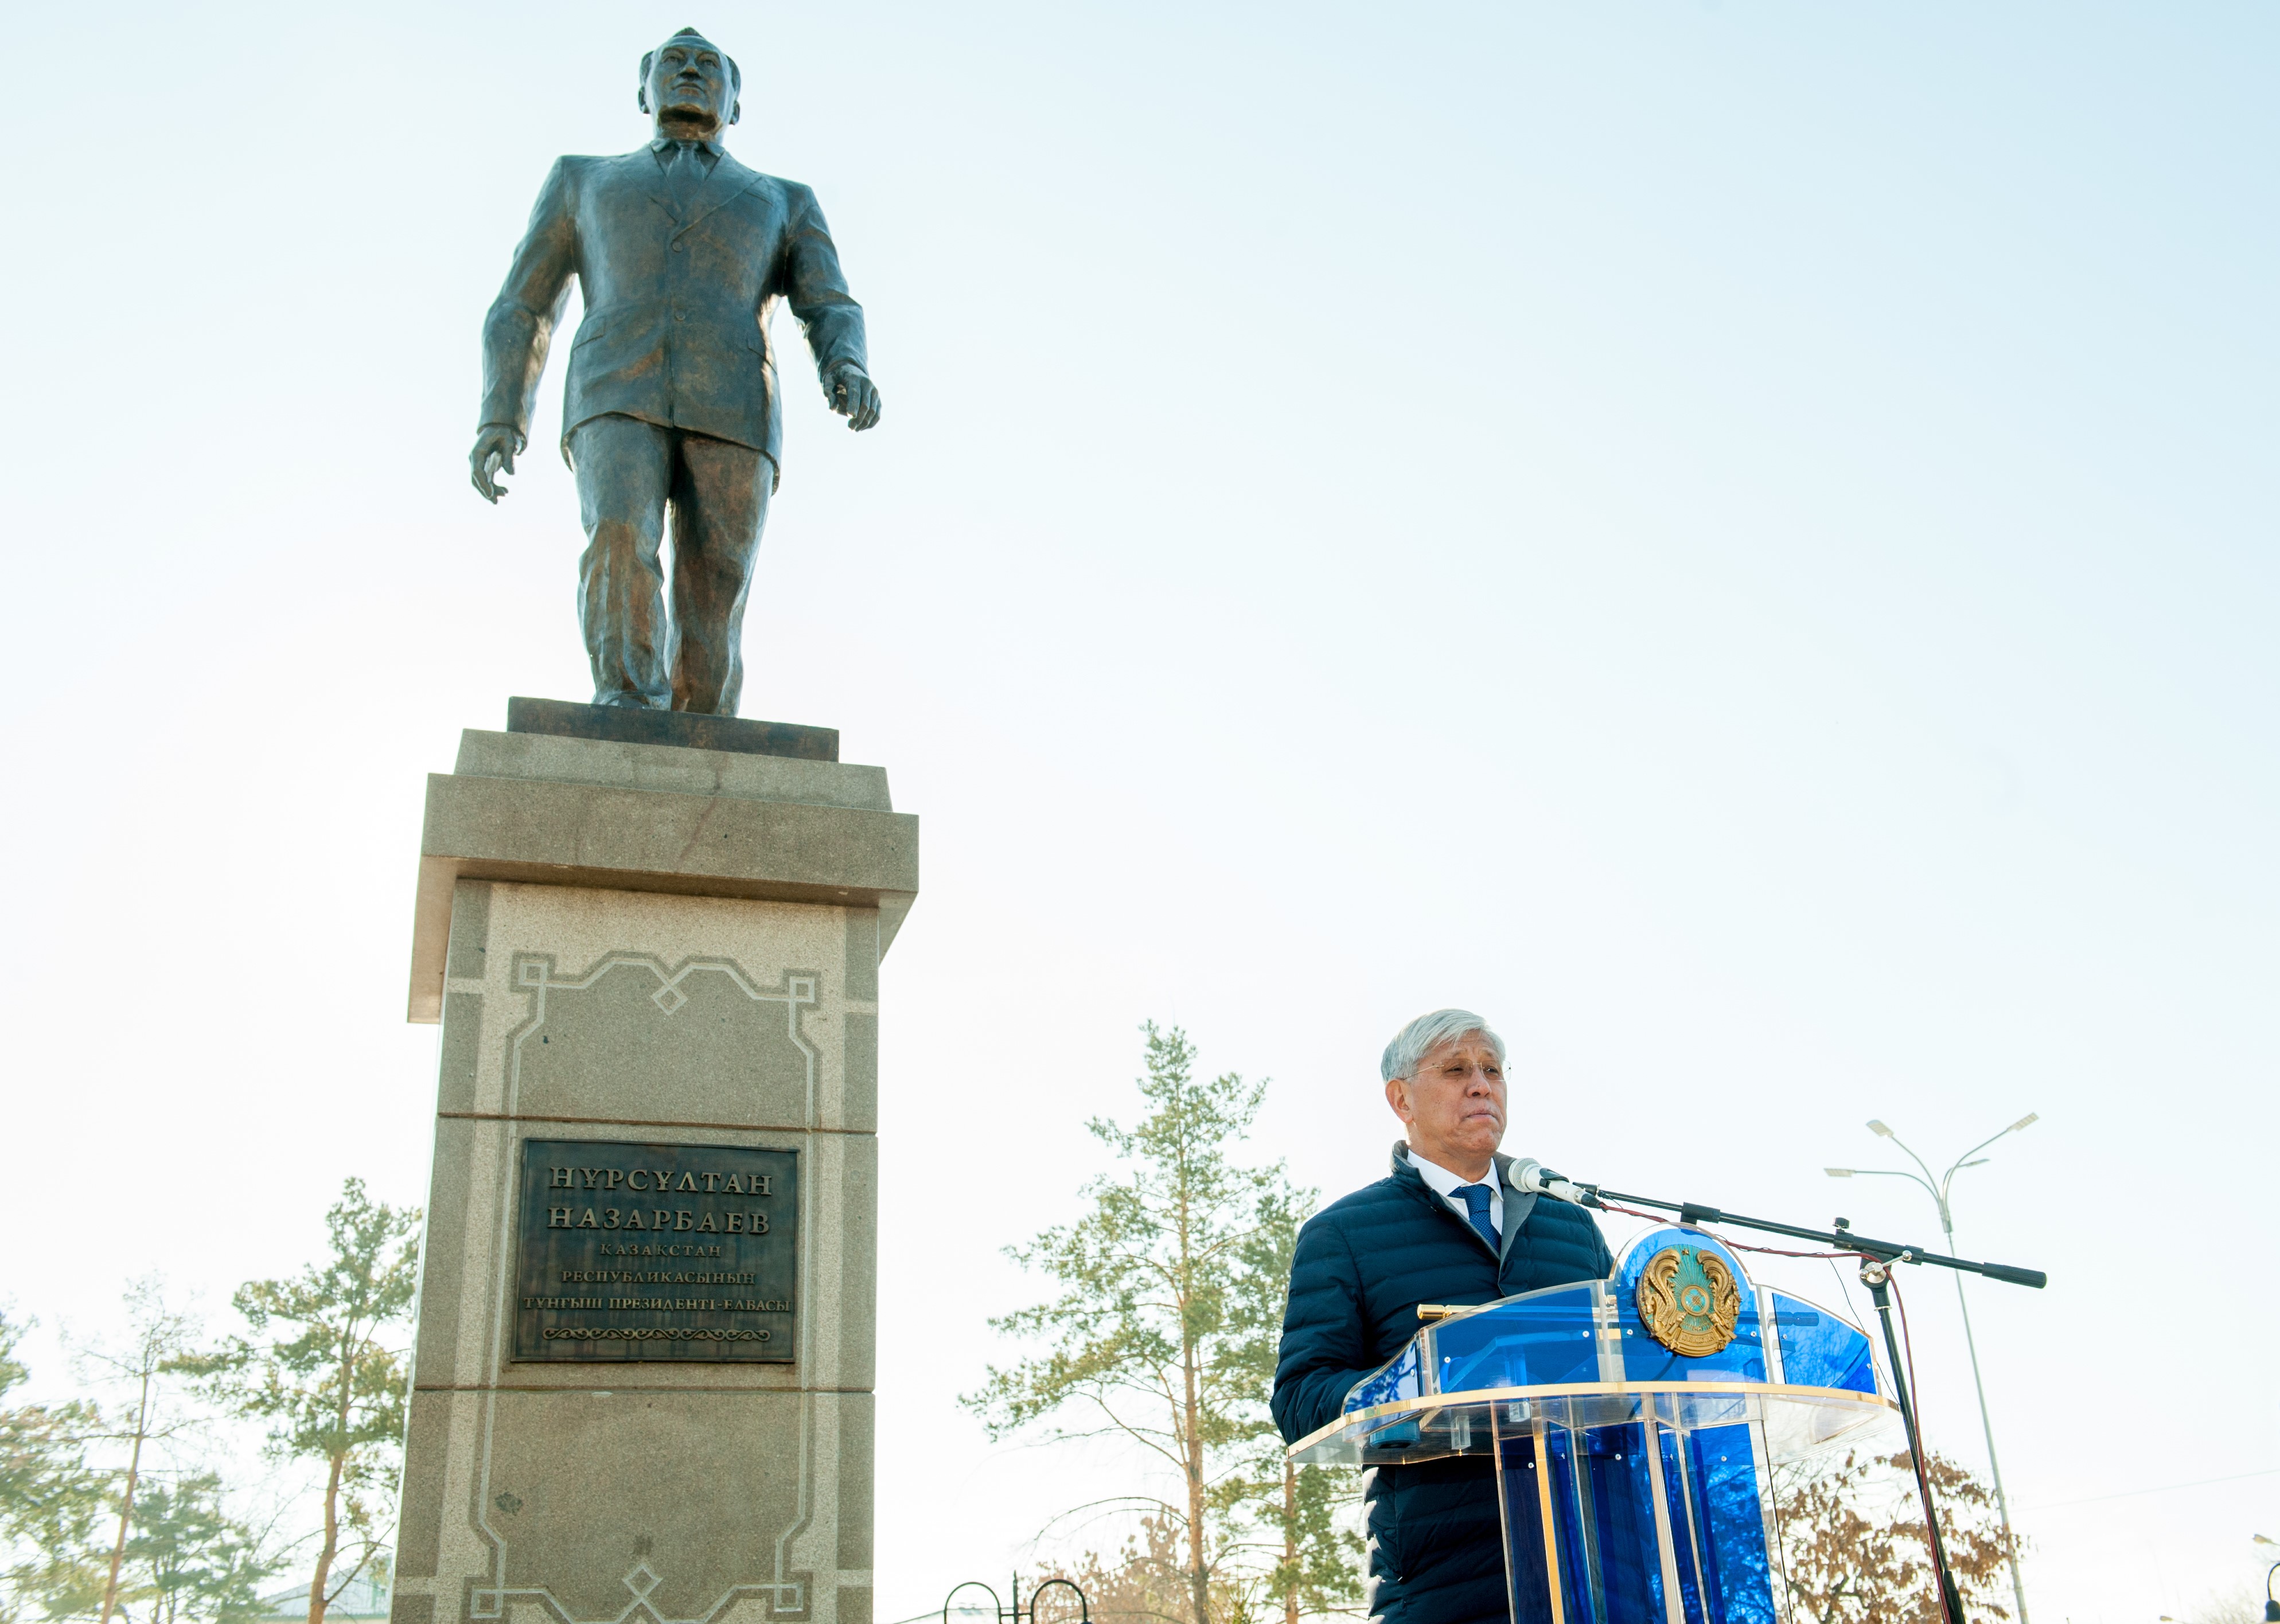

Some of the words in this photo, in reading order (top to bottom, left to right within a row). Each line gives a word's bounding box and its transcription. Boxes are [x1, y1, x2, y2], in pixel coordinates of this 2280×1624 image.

[549, 1166, 773, 1196] НҰРСҰЛТАН
[547, 1207, 770, 1234] НАЗАРБАЕВ
[600, 1243, 722, 1258] ҚАЗАҚСТАН
